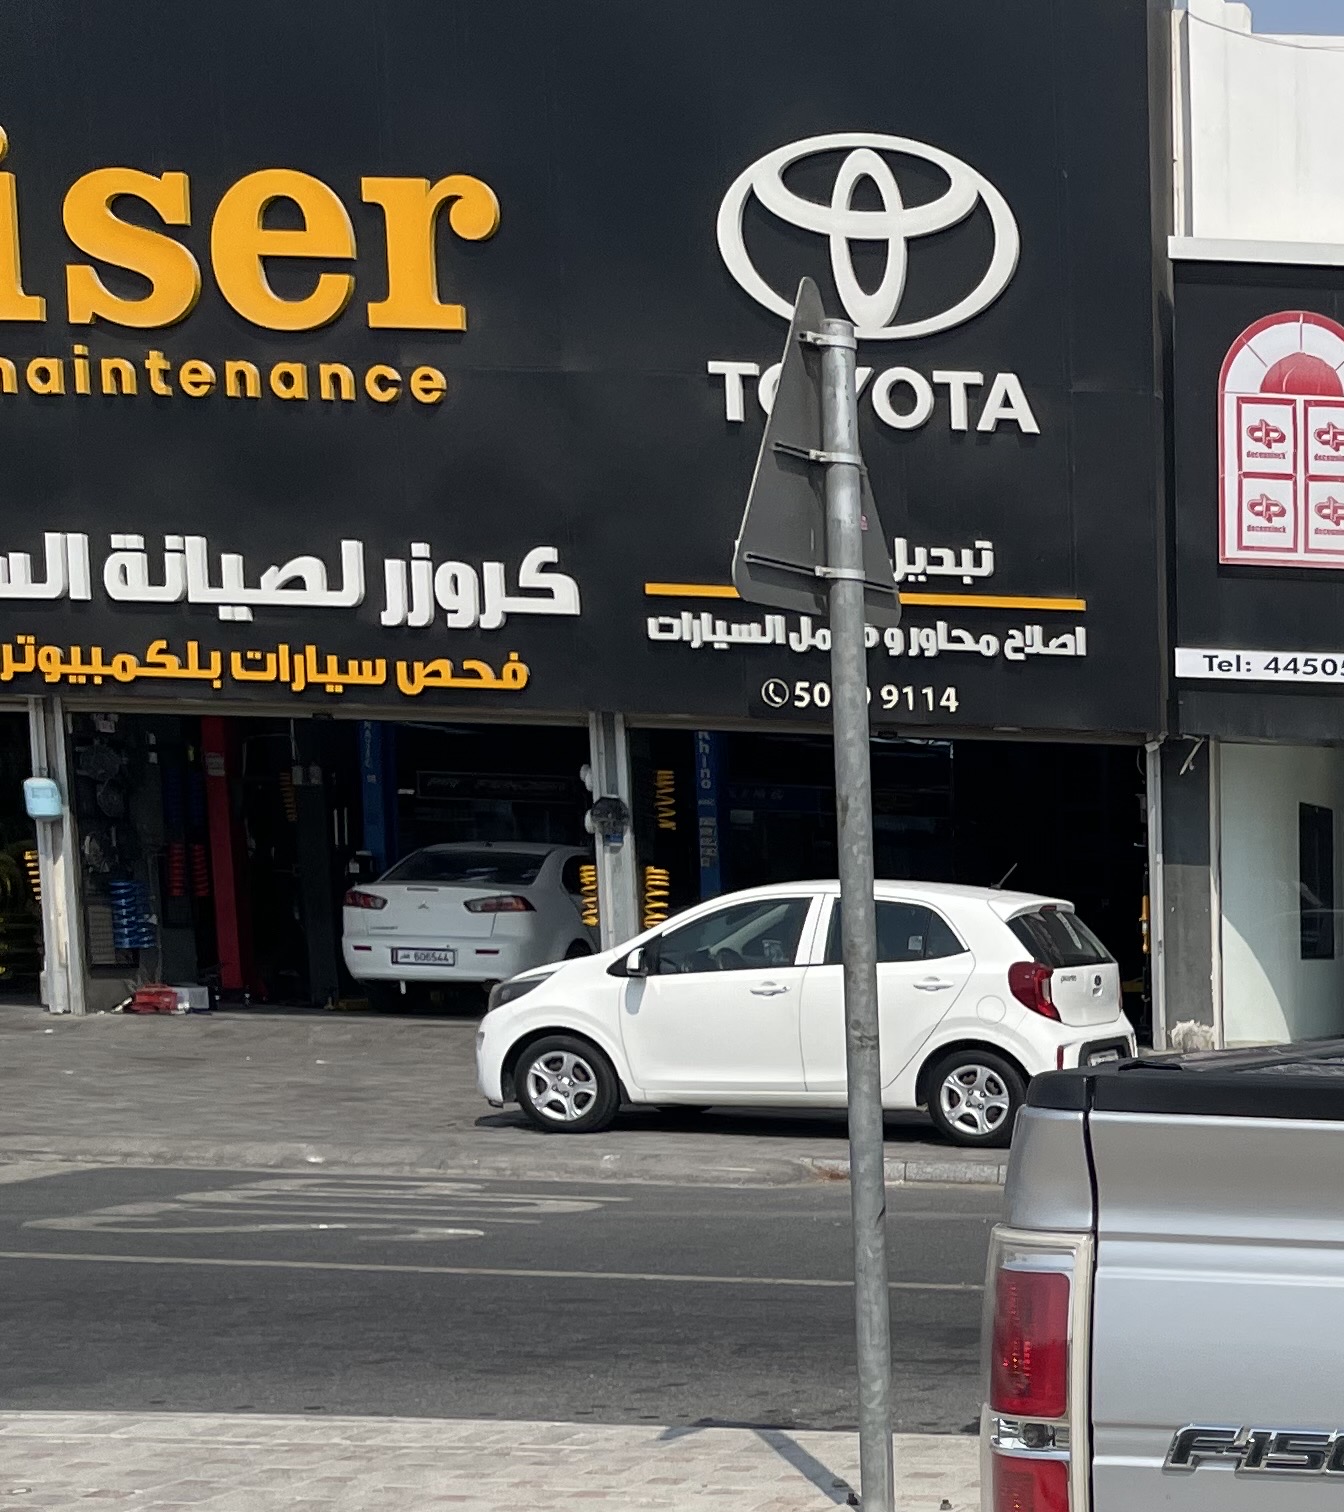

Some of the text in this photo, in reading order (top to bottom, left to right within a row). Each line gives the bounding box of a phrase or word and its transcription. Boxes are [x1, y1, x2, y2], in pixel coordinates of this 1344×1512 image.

[104, 534, 365, 621] لصيانة
[893, 537, 994, 584] تبديل
[381, 542, 581, 629] كروزر
[647, 611, 787, 649] السيارات
[908, 621, 999, 657] محاور
[1004, 625, 1087, 661] اصلاح
[0, 635, 530, 695] فحص سيارات بلكمبيوتر
[1203, 654, 1252, 674] Tel:
[881, 684, 959, 712] 9114
